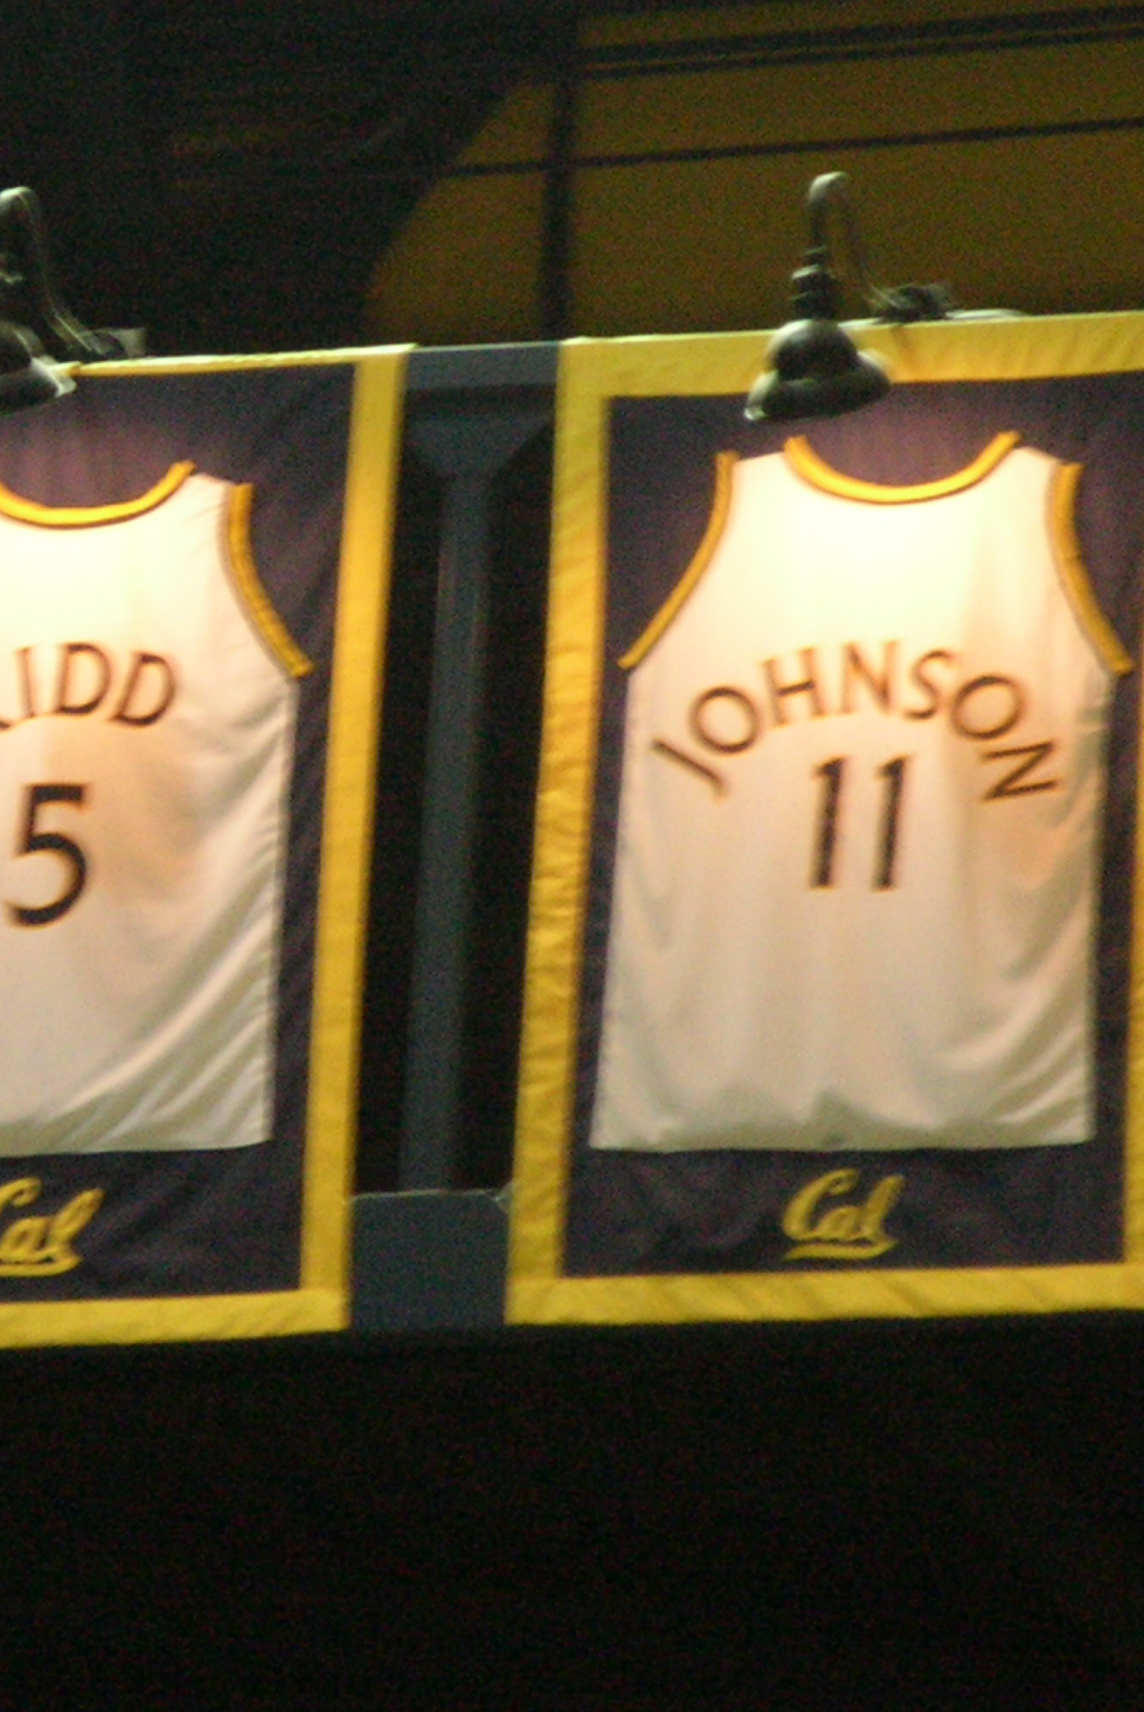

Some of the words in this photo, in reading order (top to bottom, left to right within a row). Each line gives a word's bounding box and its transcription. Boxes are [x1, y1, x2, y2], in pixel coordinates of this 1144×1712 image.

[651, 639, 1060, 803] JOHNSON
[6, 782, 89, 928] 5
[810, 755, 909, 891] 11
[782, 1168, 904, 1261] Cal
